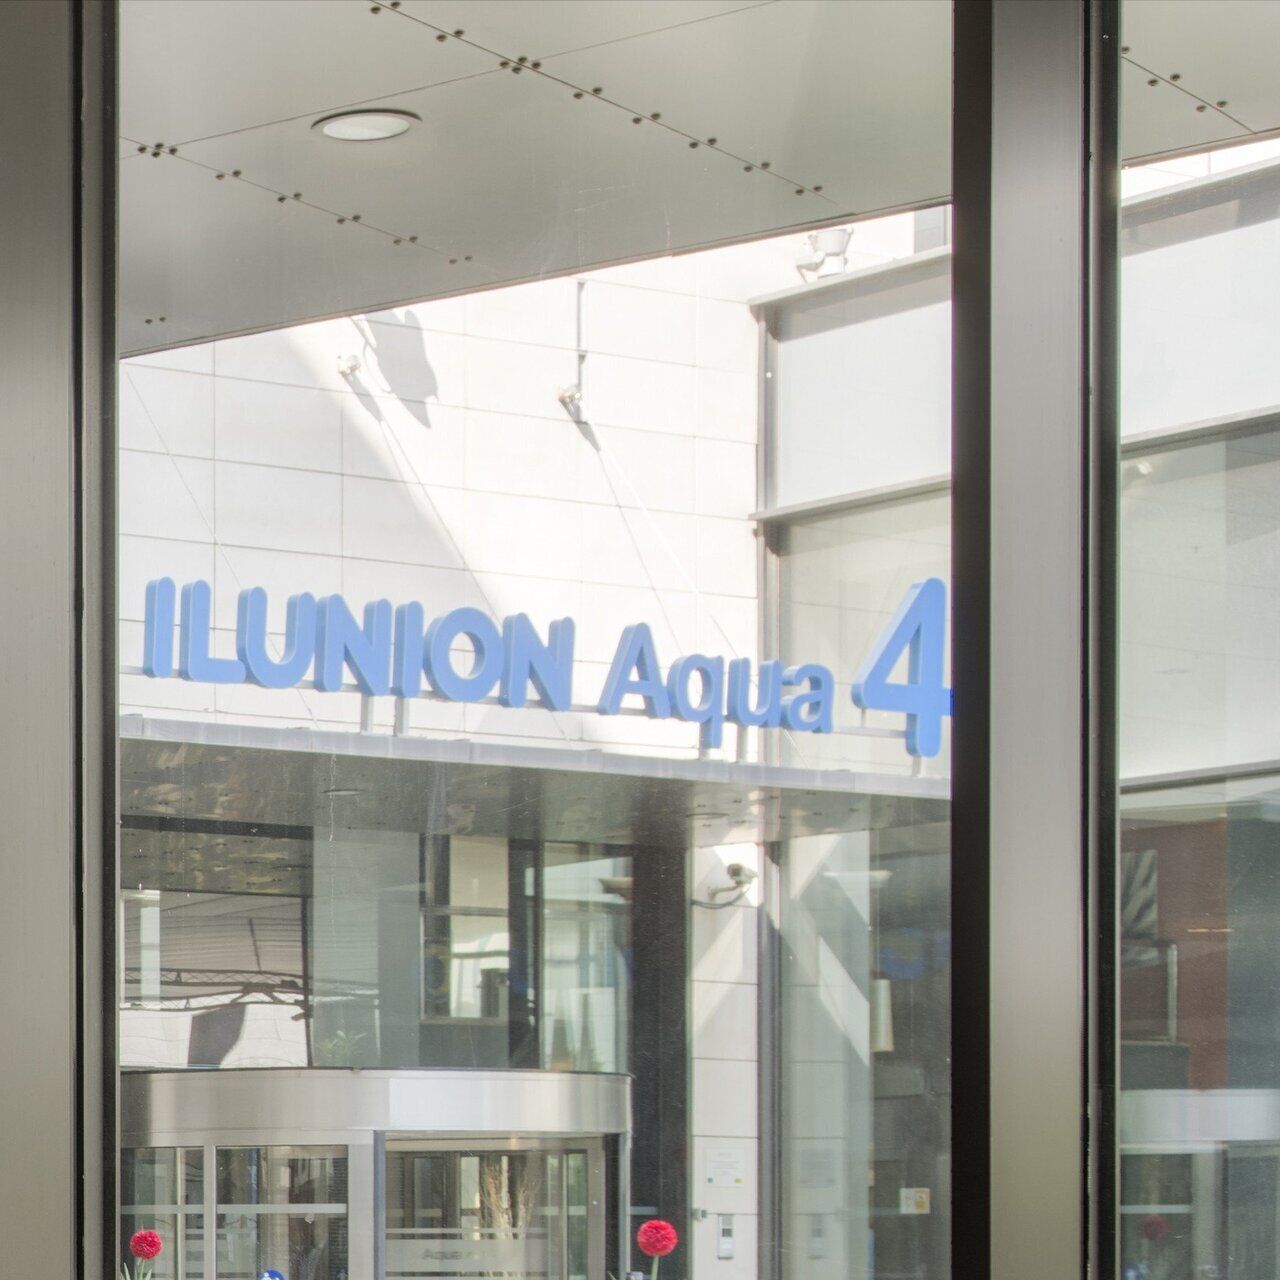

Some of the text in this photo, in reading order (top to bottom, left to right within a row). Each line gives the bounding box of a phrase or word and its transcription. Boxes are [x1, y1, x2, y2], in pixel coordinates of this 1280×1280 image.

[143, 576, 952, 758] ILUNION Aqua 4
